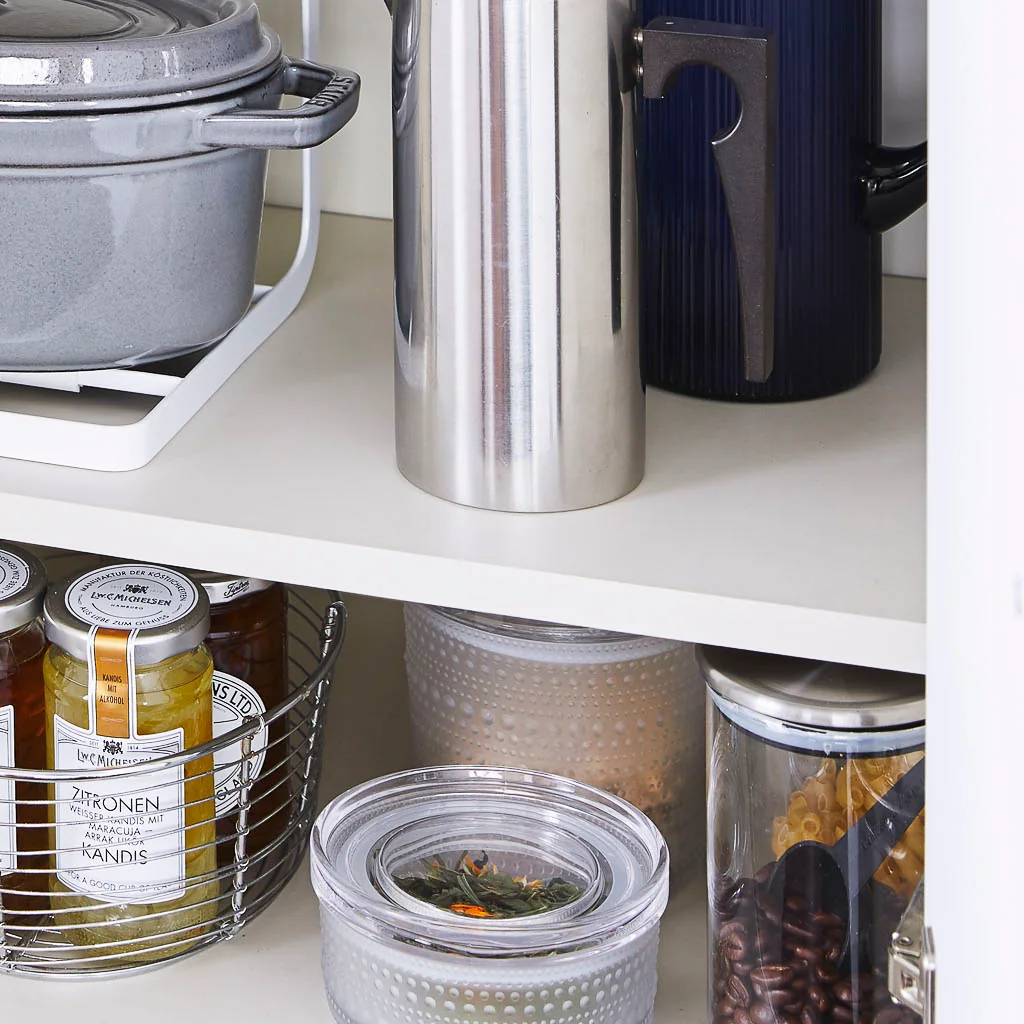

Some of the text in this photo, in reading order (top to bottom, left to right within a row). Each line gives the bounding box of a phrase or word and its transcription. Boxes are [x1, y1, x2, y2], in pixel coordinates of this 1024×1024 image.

[80, 570, 127, 592] MANUFAKTUR
[79, 605, 92, 616] AUS
[102, 674, 123, 684] KANDIS
[107, 685, 117, 693] MIT
[99, 695, 125, 705] ALKOHOL
[229, 690, 252, 715] LTD
[72, 785, 160, 813] ZITRONEN
[147, 814, 164, 824] MIT
[88, 822, 141, 836] MARACUJA
[84, 831, 114, 844] ARRAK
[82, 842, 148, 864] KANDIS
[89, 879, 116, 891] GOOD
